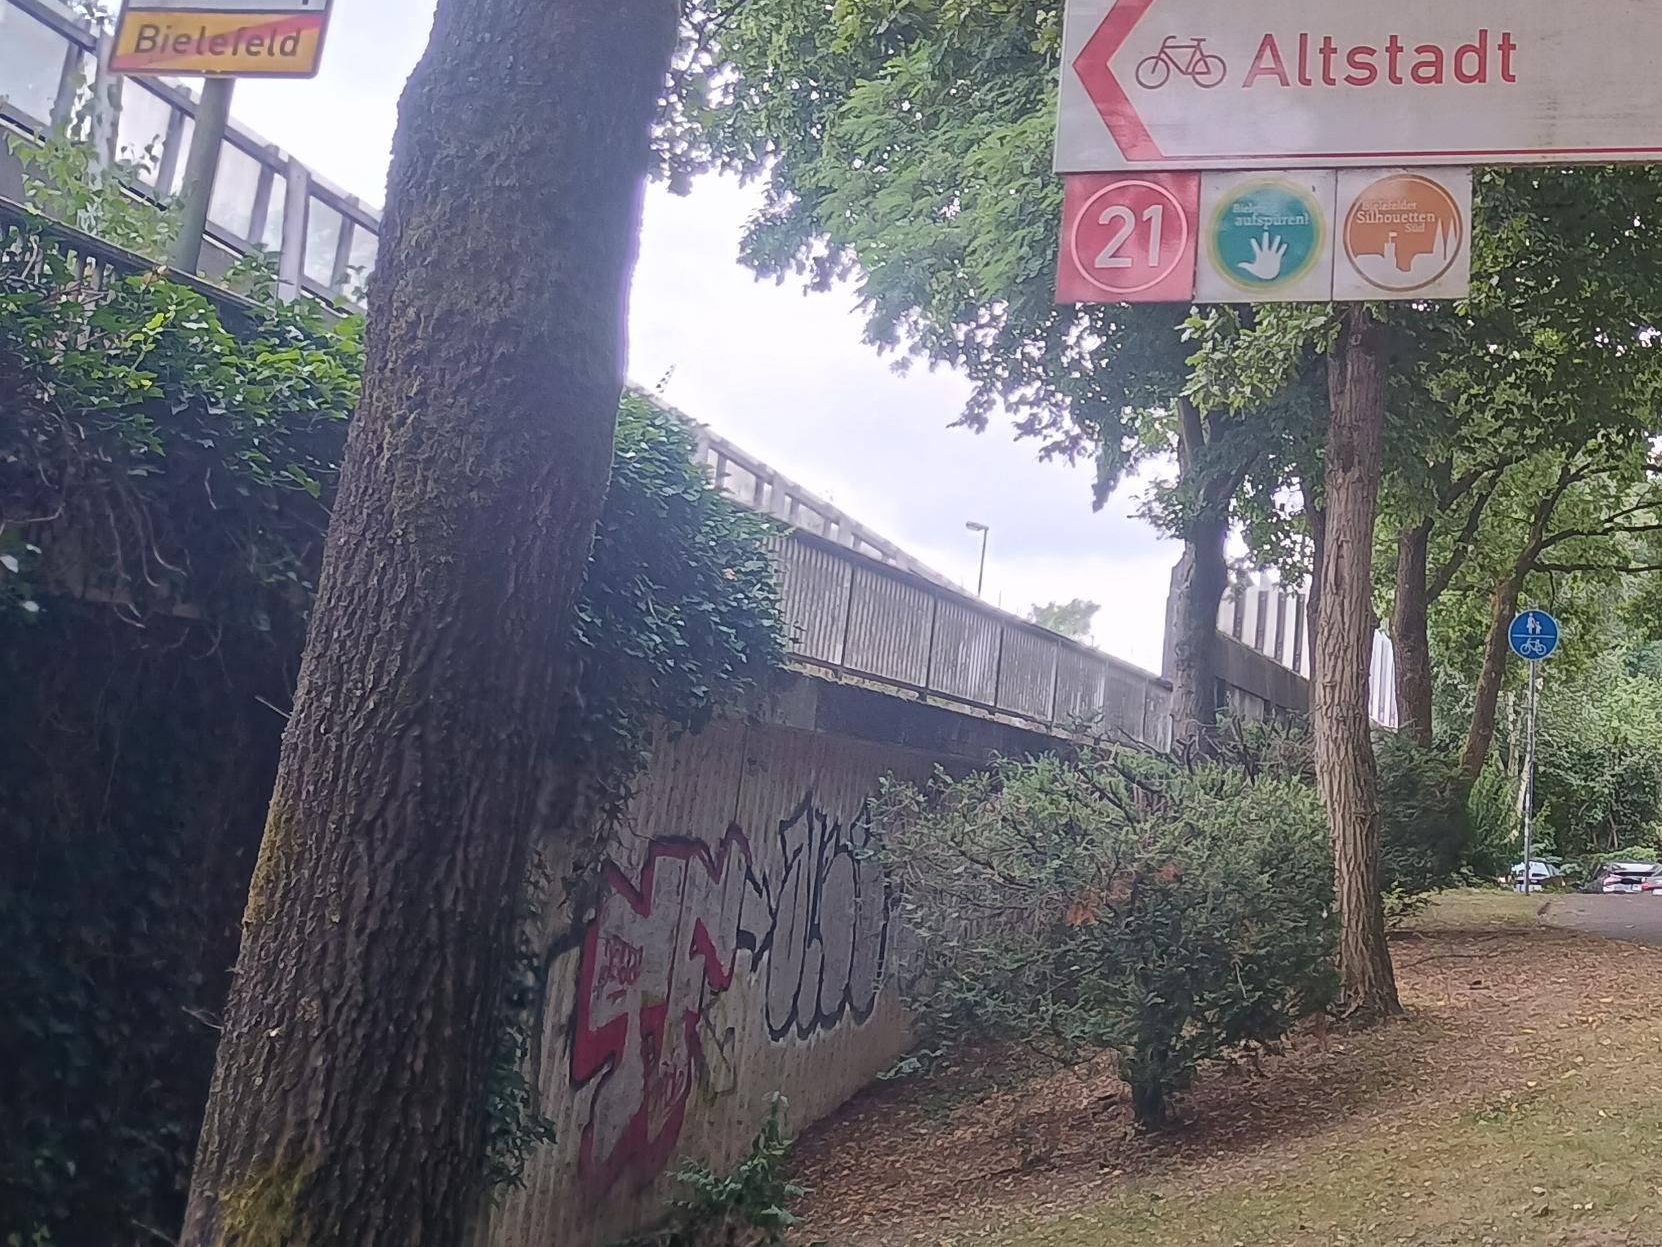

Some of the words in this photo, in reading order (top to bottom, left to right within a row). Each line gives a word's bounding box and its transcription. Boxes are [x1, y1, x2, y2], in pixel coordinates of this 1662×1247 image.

[134, 24, 301, 57] Bielefeld
[1242, 29, 1517, 88] Altstadt
[1095, 204, 1163, 268] 21
[1356, 210, 1436, 224] Silhouetten
